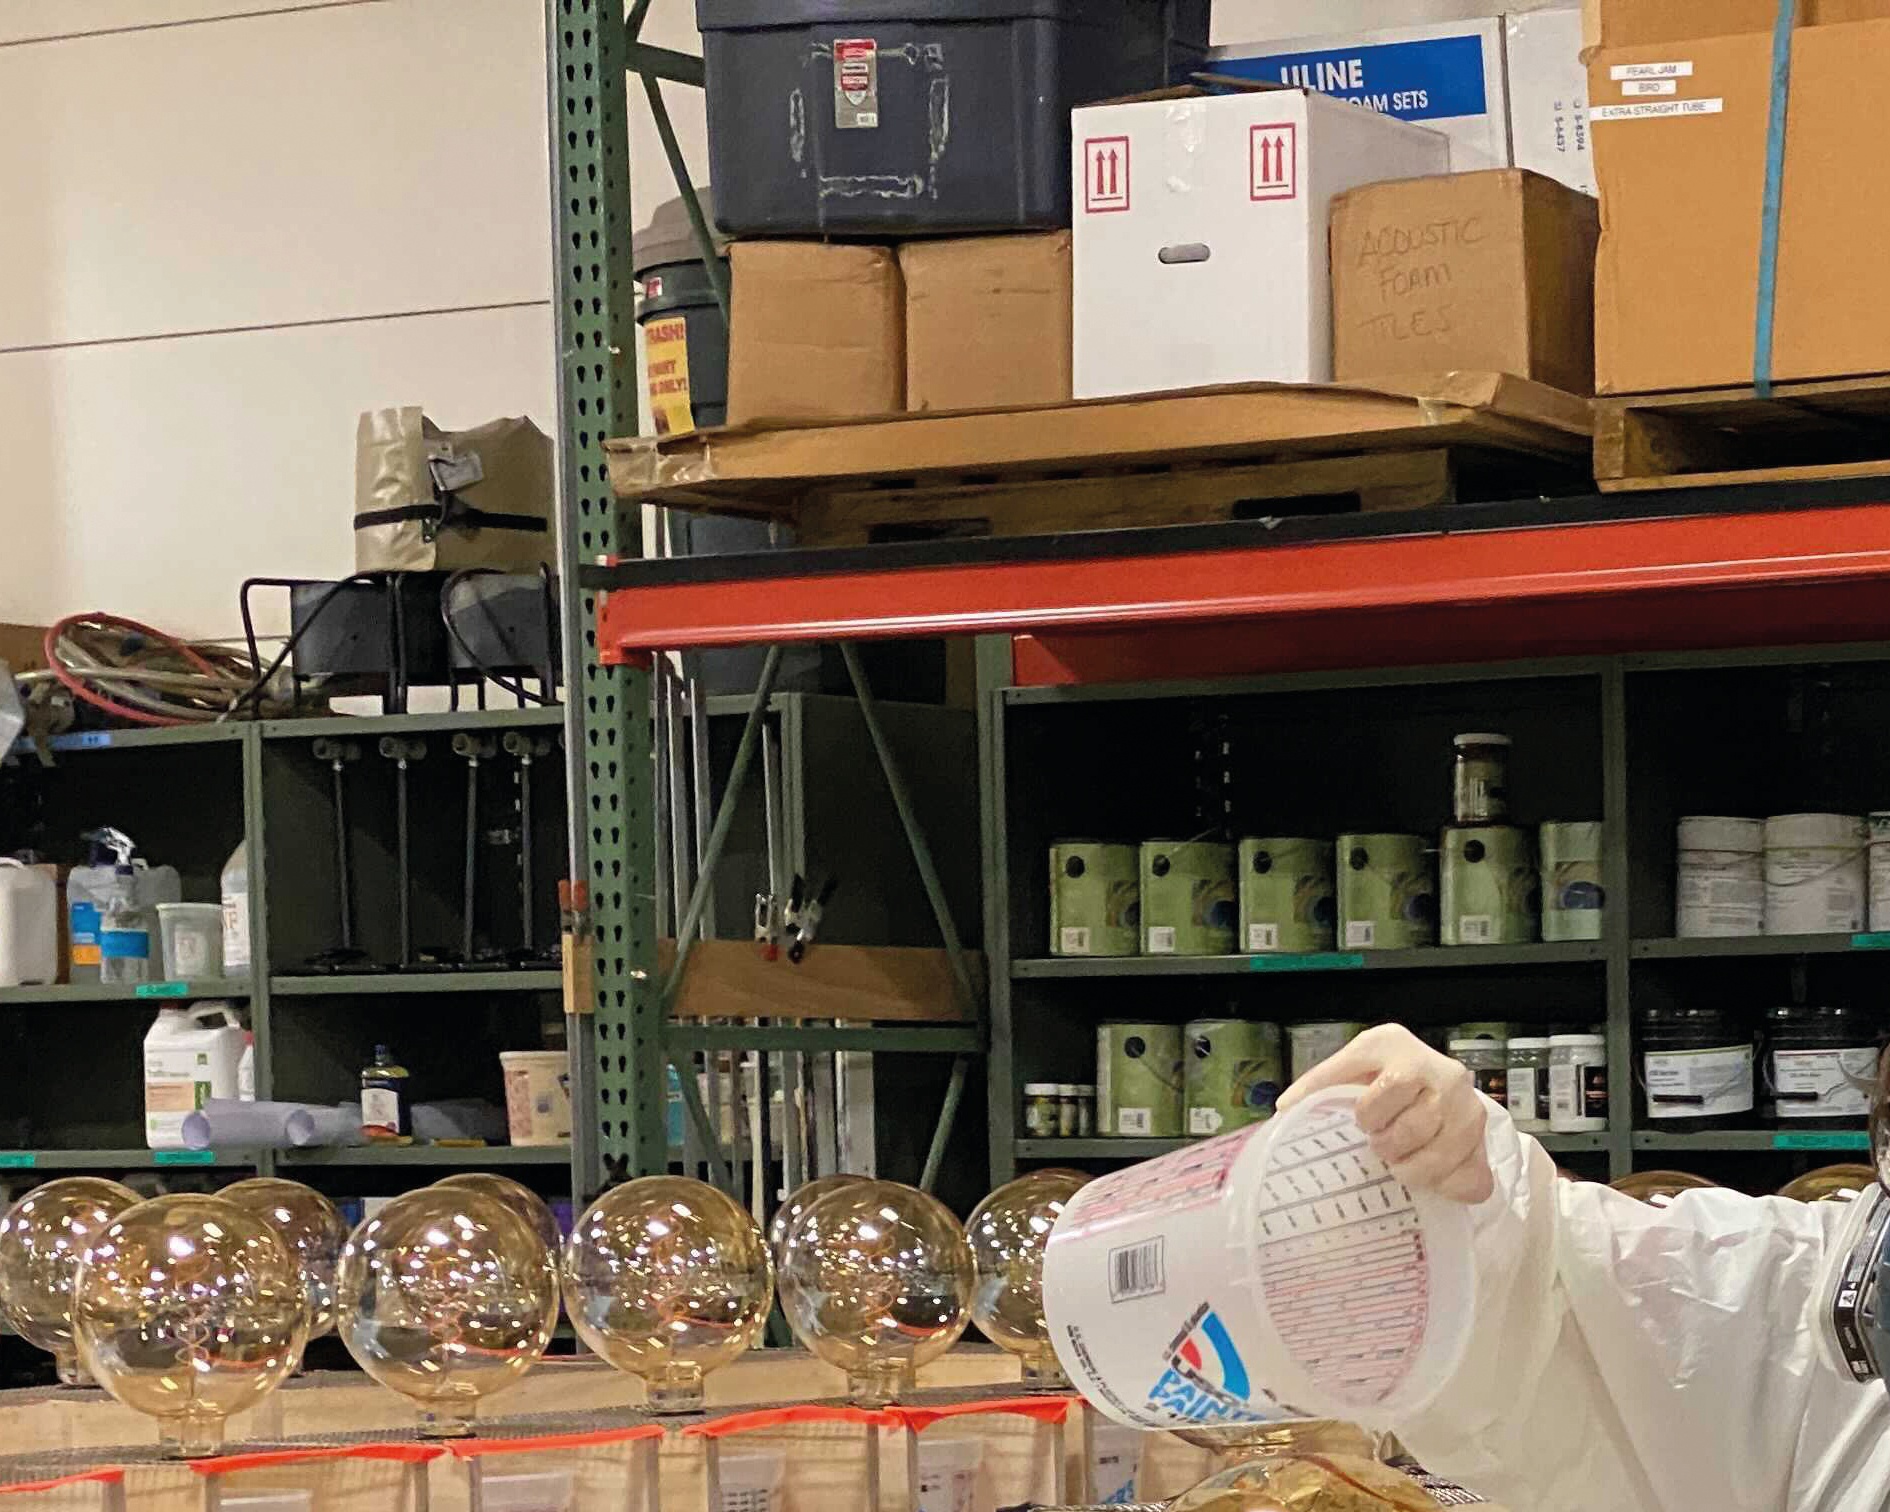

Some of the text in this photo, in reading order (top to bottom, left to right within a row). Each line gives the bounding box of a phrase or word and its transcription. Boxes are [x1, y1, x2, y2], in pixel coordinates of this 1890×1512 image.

[1393, 90, 1429, 111] SETS
[1602, 101, 1707, 118] EXTRA STRAIGHT TUBE
[1357, 215, 1490, 268] ACOUSTIC
[1379, 262, 1452, 303] FOAM
